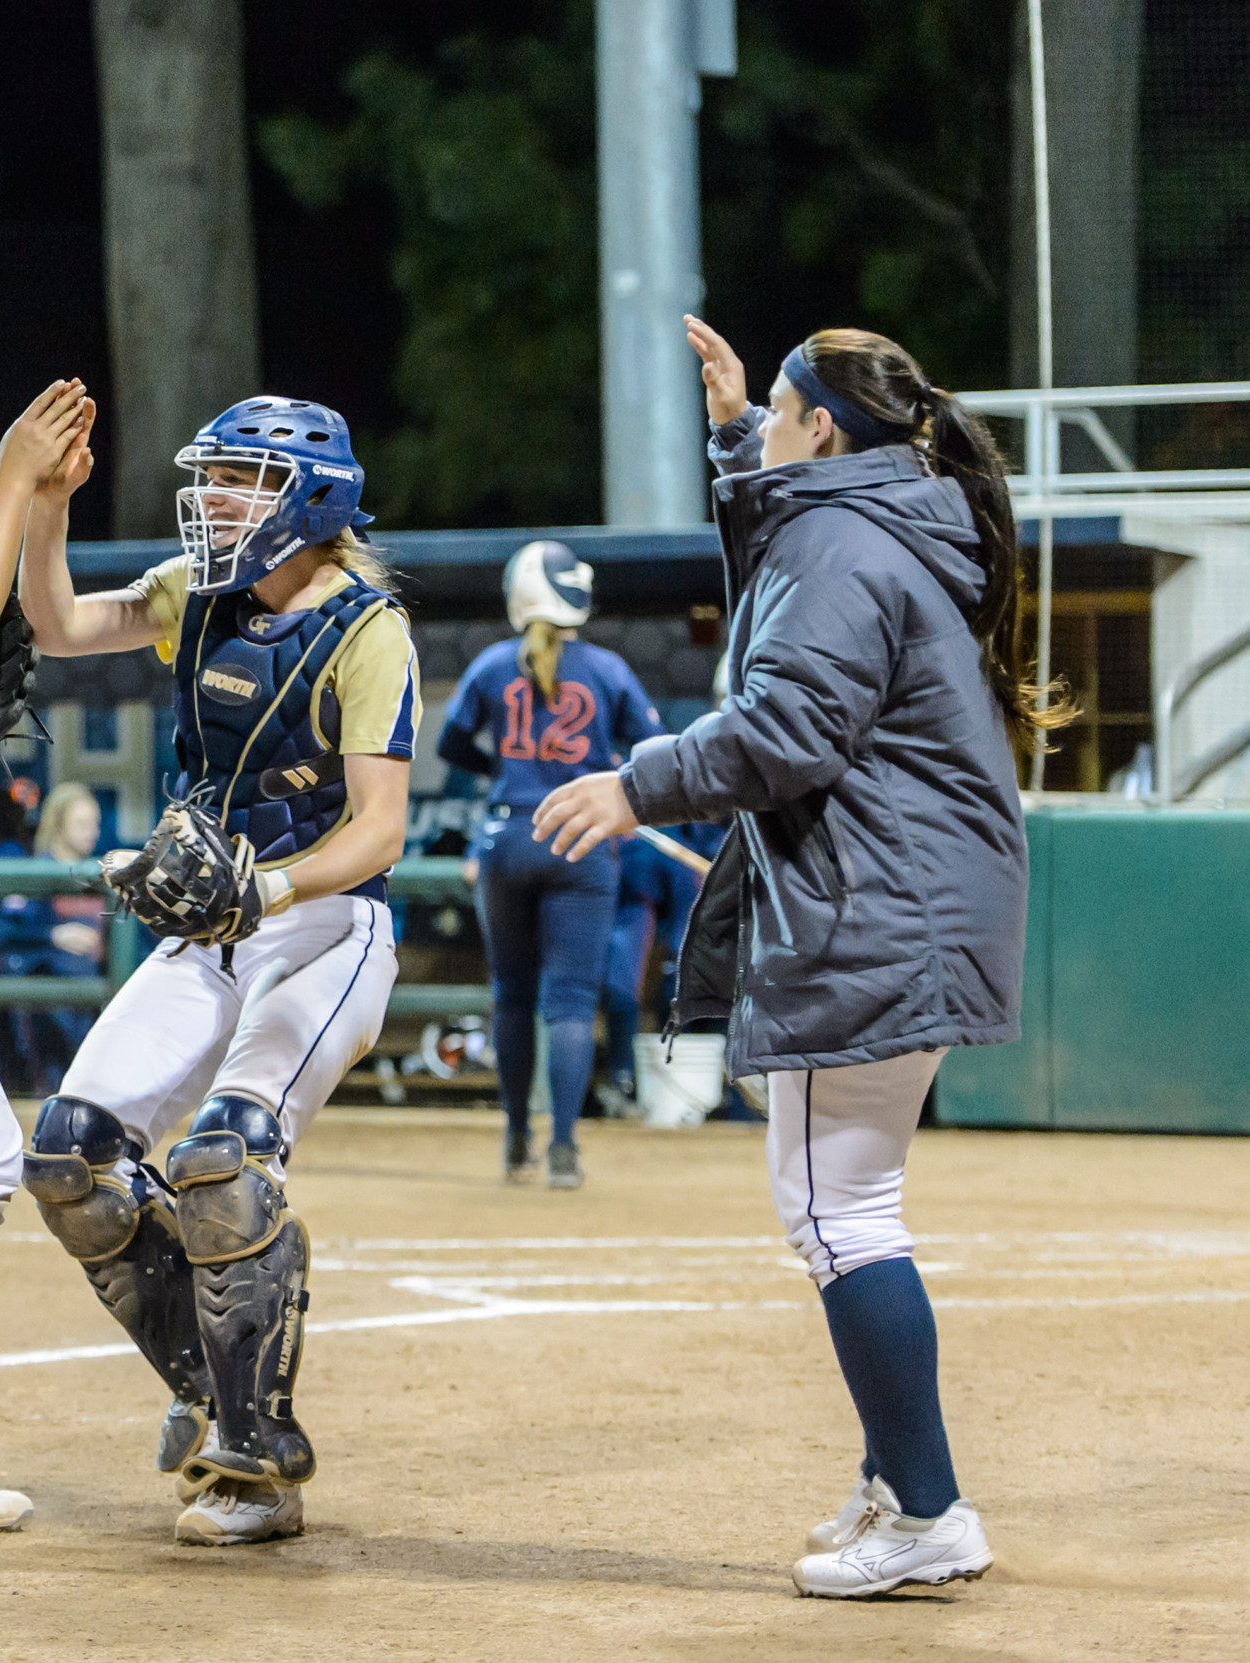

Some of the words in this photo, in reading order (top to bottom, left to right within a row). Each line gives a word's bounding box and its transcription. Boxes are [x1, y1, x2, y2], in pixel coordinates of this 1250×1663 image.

[321, 466, 354, 481] WORTH
[273, 537, 305, 565] WORTH
[202, 669, 257, 698] WORTH
[501, 676, 596, 764] 12
[277, 1320, 295, 1377] WORTH
